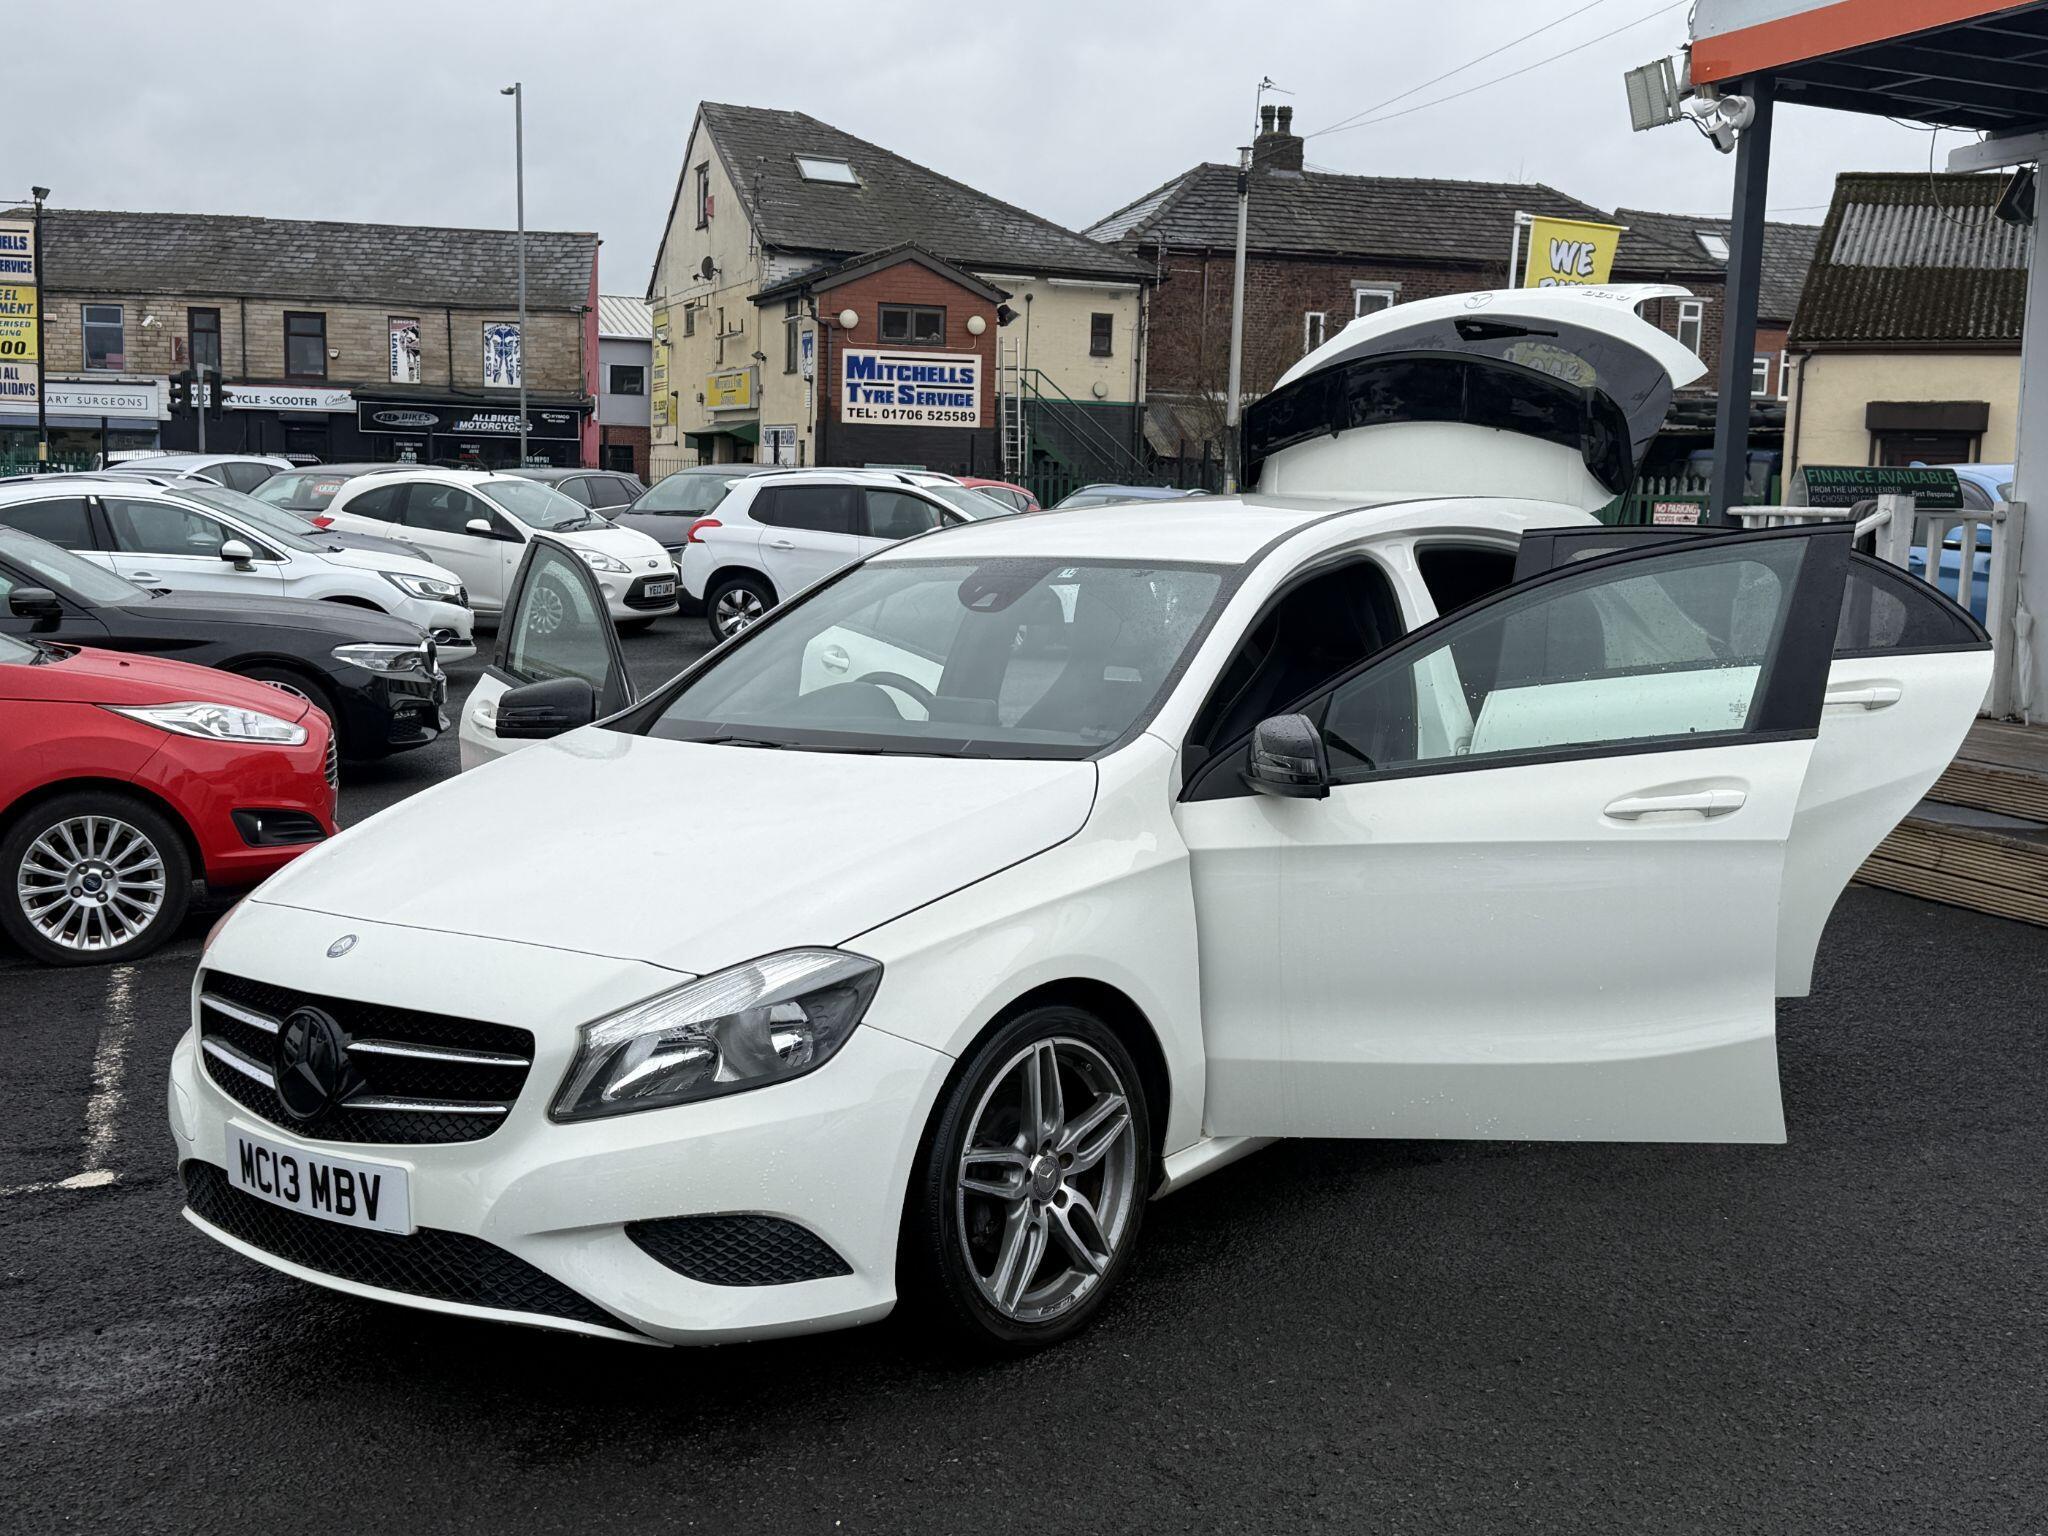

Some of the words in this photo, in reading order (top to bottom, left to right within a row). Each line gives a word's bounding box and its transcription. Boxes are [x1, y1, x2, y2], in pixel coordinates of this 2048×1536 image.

[0, 236, 28, 250] ELLS
[1549, 237, 1596, 277] WE
[4, 367, 19, 380] ALL
[846, 355, 975, 384] MITCHELLS
[77, 396, 142, 407] SURGEONS
[269, 396, 318, 407] SCOOTER
[846, 382, 894, 404] TYRE
[898, 384, 974, 407] SERVICE
[847, 407, 877, 418] TEL:
[881, 409, 923, 420] 01706
[927, 410, 976, 422] 525589
[1807, 469, 1874, 483] FINANCE
[1878, 470, 1958, 485] AVAILABLE
[1926, 490, 1955, 499] Response
[1655, 503, 1666, 512] NO
[1667, 503, 1697, 514] PARKING
[239, 1138, 300, 1203] MC13
[309, 1161, 381, 1221] MBV
